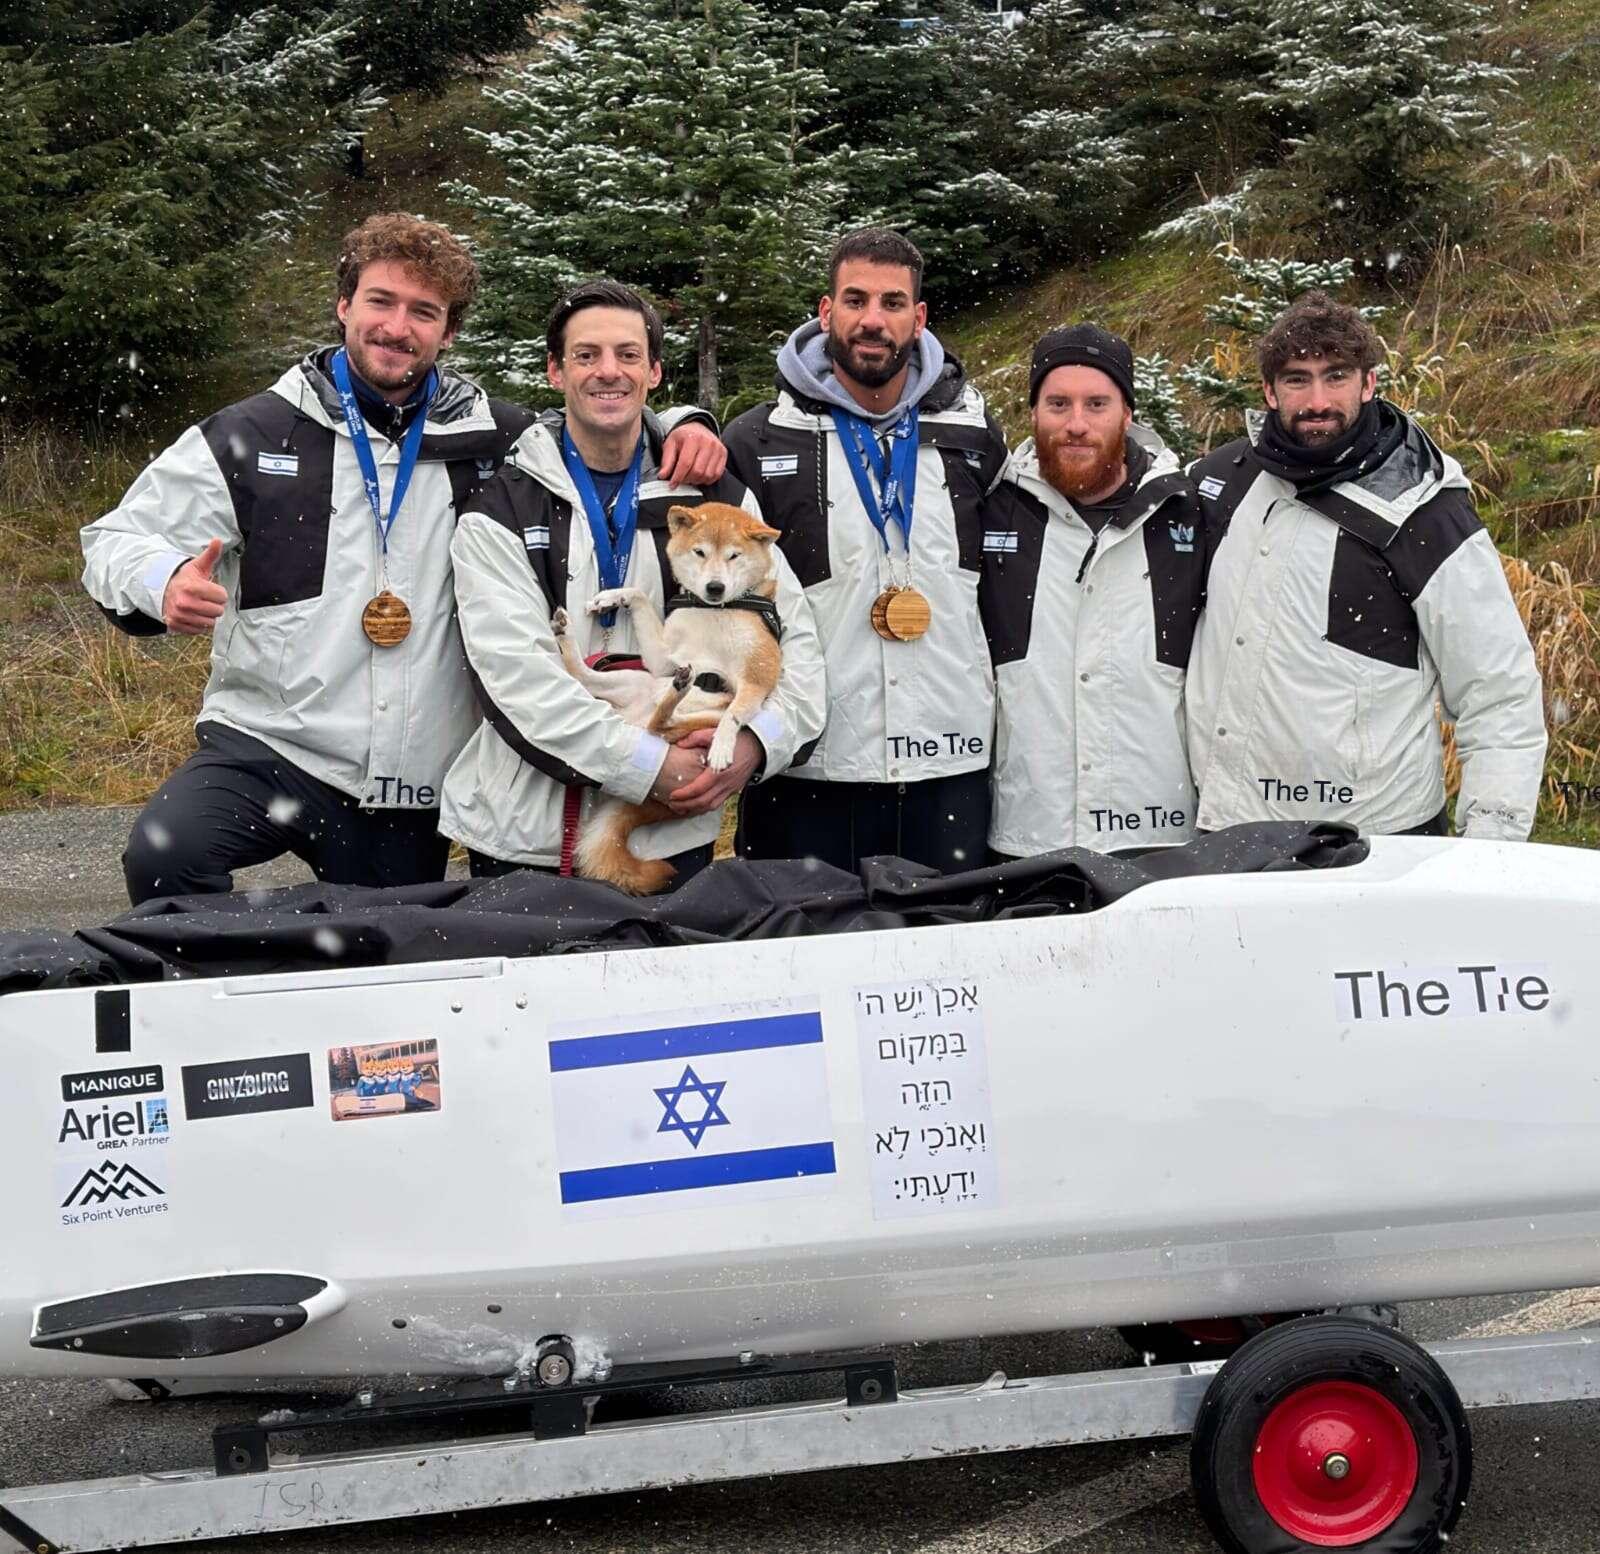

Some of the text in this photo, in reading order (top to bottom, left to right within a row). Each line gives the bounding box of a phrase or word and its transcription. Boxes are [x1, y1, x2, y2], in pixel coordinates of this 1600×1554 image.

[886, 736, 939, 758] The
[374, 776, 435, 806] The
[1258, 778, 1309, 802] The
[1089, 809, 1141, 832] The
[1334, 965, 1550, 1019] The Tie
[70, 1072, 157, 1095] MANIQUE
[206, 1070, 290, 1102] GINZBURG
[58, 1100, 145, 1143] Ariel
[96, 1136, 170, 1151] GREA Partner
[62, 1202, 169, 1226] Six Point Ventures
